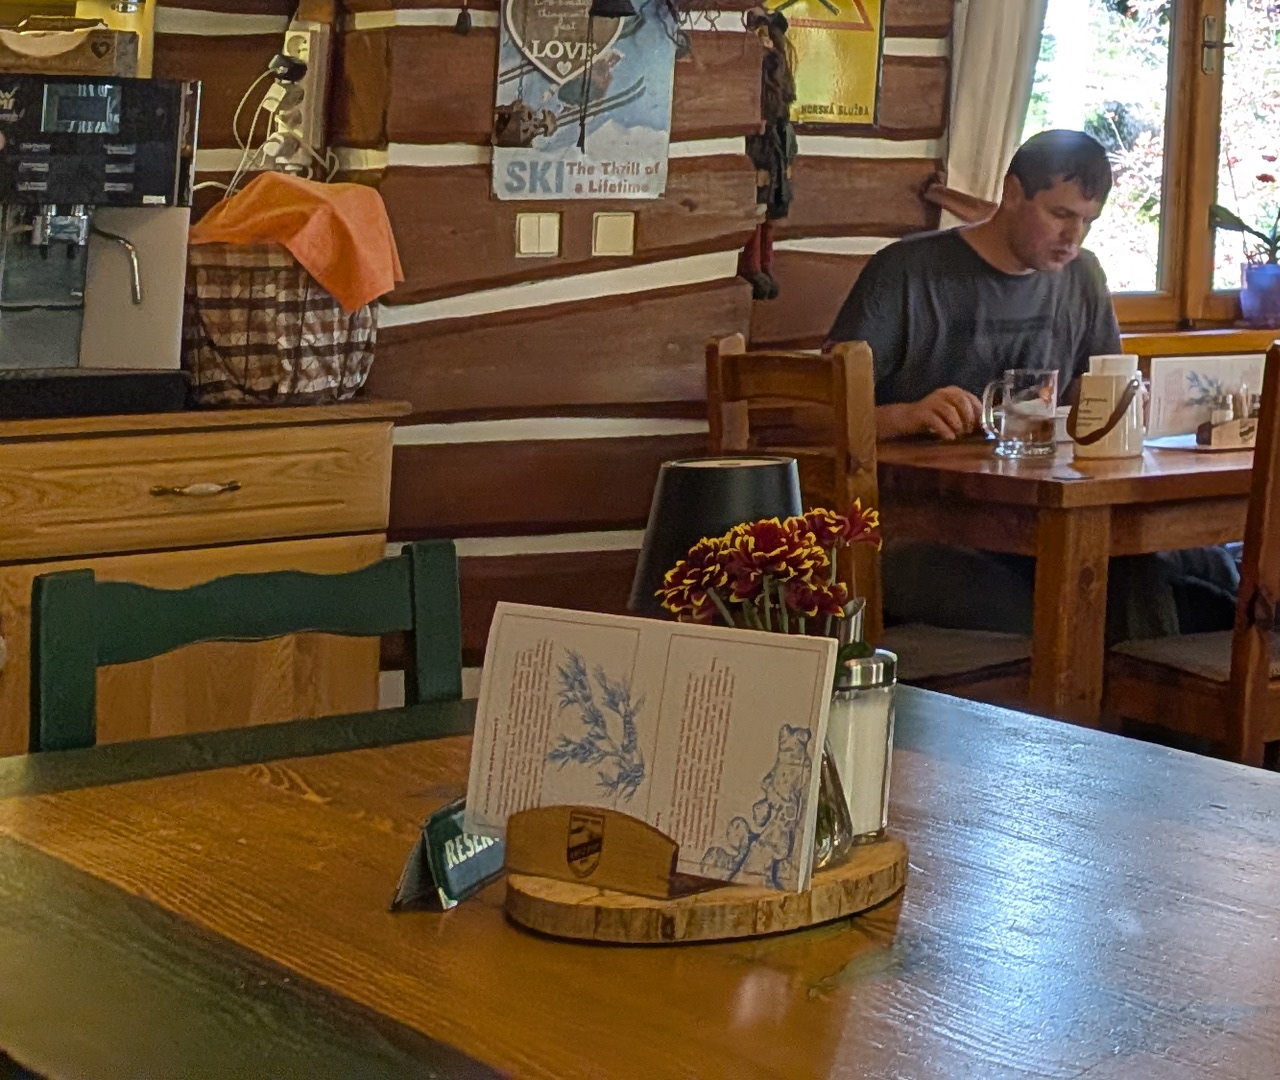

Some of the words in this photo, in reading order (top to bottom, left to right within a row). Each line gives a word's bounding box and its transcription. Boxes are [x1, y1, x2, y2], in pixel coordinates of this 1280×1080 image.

[801, 102, 835, 115] HORSKÁ
[837, 103, 870, 116] SLUŽBA
[504, 160, 565, 194] SKI
[566, 161, 595, 176] The
[601, 161, 641, 176] Thrill
[645, 162, 661, 176] of
[574, 182, 584, 194] a
[588, 179, 649, 195] Lifetime
[444, 832, 500, 870] RESER
